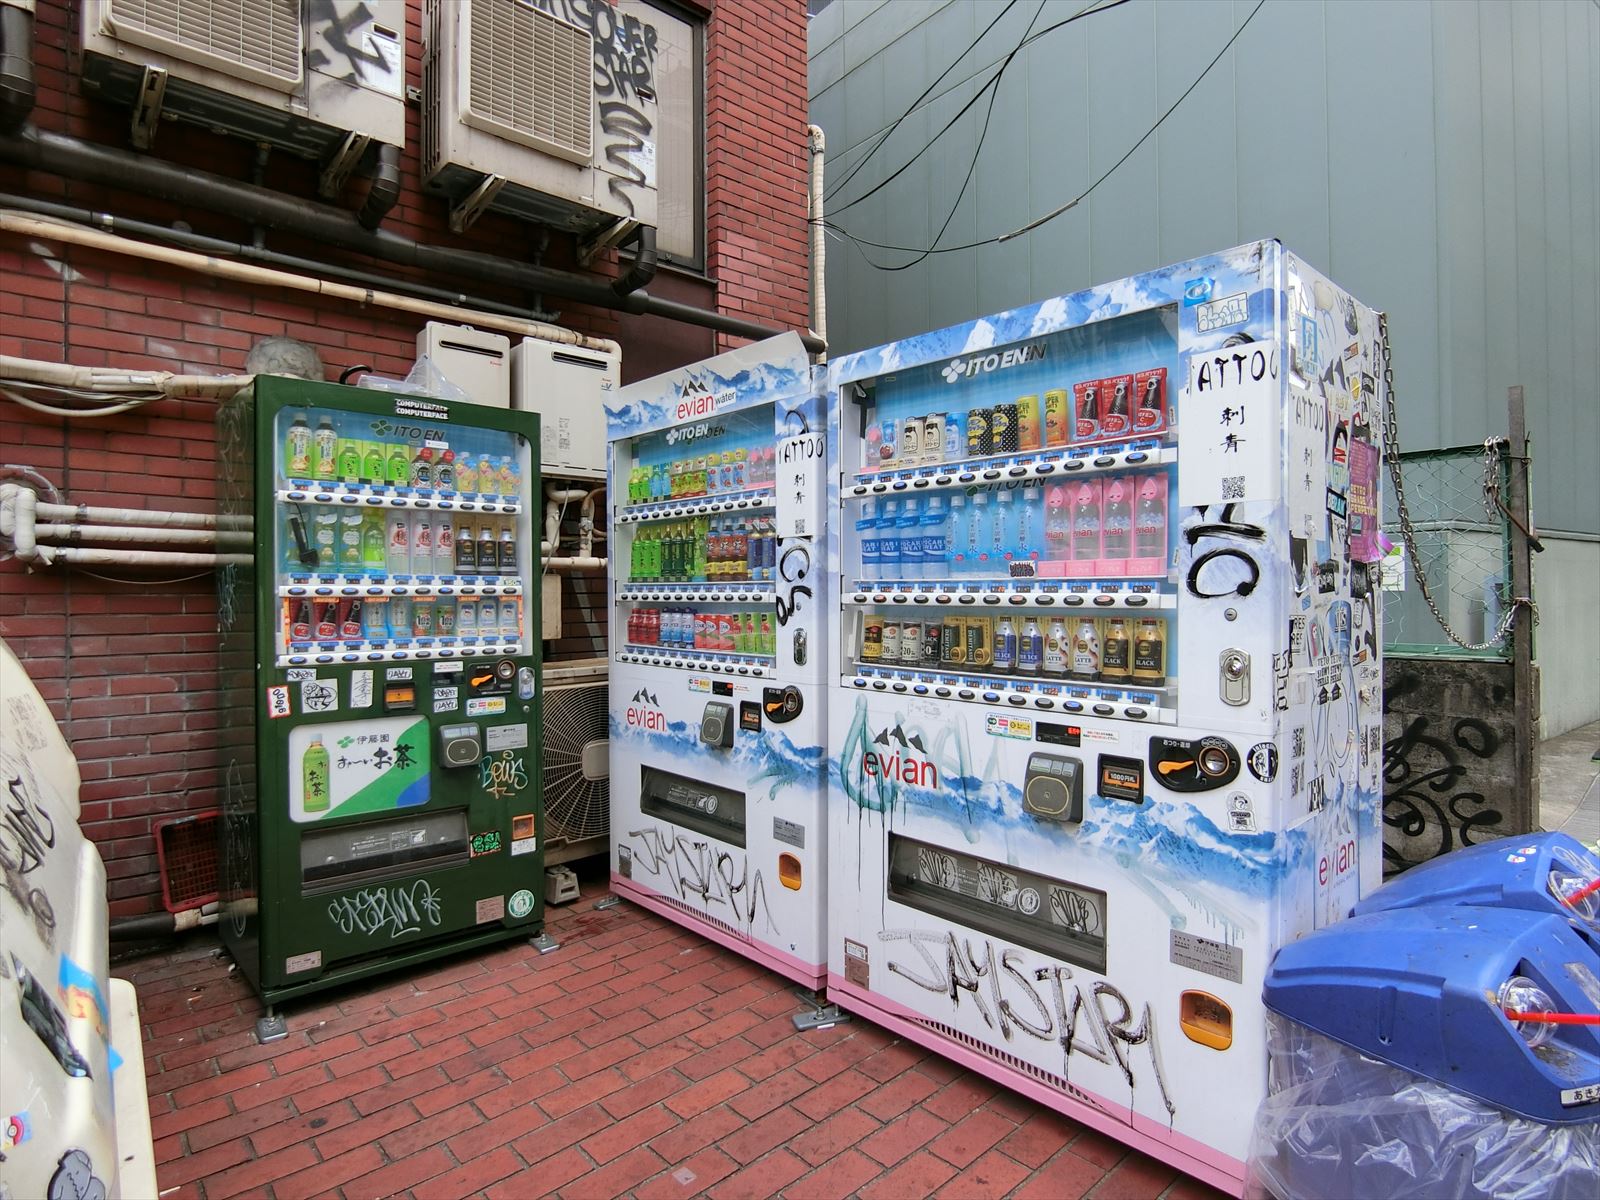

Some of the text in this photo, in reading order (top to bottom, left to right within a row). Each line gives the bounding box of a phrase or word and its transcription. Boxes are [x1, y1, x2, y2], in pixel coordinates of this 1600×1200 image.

[966, 345, 1028, 376] ITO EN
[1186, 349, 1278, 394] ATTOO
[395, 407, 449, 420] COMPUTERFACE
[677, 391, 735, 419] evian water
[394, 426, 445, 441] ITO EN
[679, 427, 695, 441] ITO
[695, 423, 709, 437] EN
[1219, 405, 1246, 454] 刺青
[626, 706, 666, 732] evian
[863, 750, 937, 789] evian
